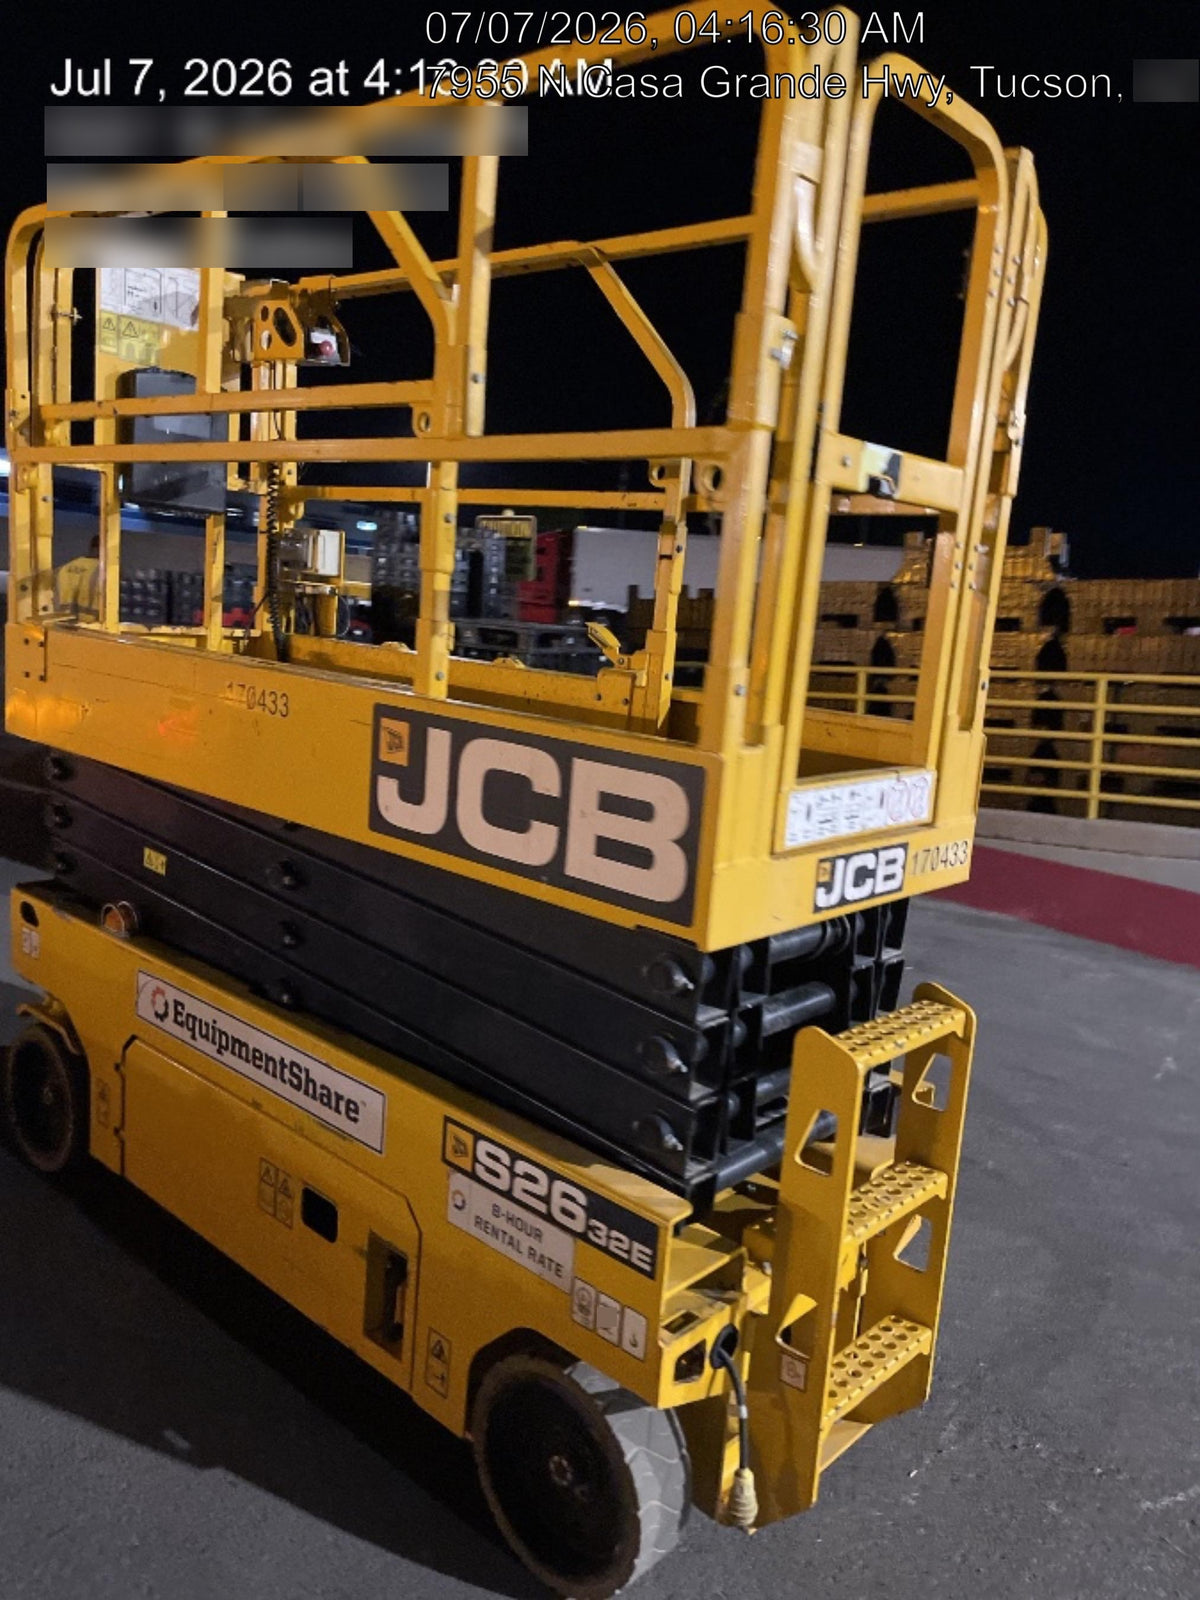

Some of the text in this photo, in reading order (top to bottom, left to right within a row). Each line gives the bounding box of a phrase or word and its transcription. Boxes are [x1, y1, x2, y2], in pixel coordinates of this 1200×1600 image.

[376, 726, 690, 904] JCB
[815, 847, 906, 908] JCB
[912, 840, 969, 875] 170433
[173, 999, 360, 1124] EquipmentShare
[474, 1214, 565, 1278] RENTAL RATE
[491, 1202, 544, 1243] 8-HOUR
